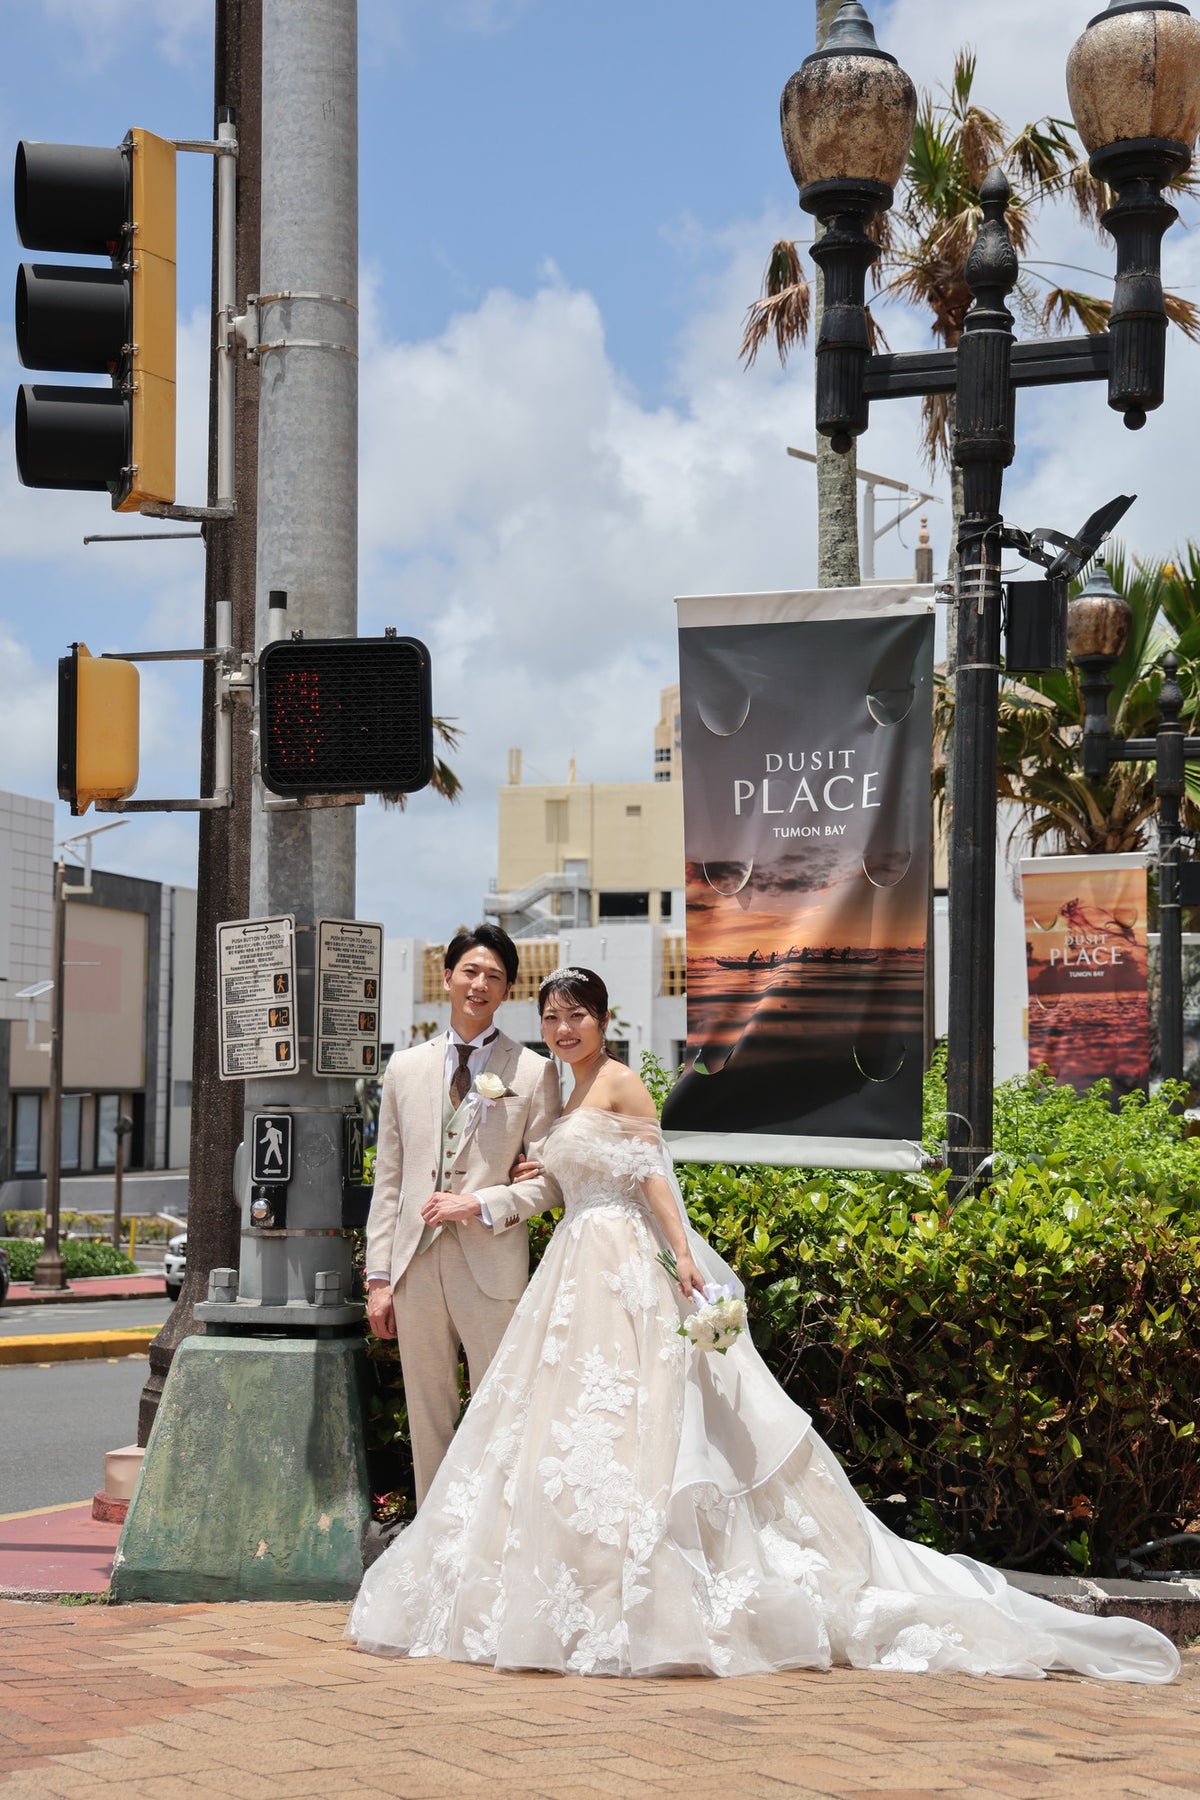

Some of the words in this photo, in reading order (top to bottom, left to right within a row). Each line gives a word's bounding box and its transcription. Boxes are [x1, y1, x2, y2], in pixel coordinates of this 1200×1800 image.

[765, 750, 856, 773] DUSIT
[733, 771, 881, 816] PLACE
[772, 826, 820, 838] TUMON
[824, 824, 847, 836] BAY
[1064, 933, 1109, 946] DUSIT
[1050, 945, 1124, 966] PLACE
[1069, 970, 1092, 978] TUMON
